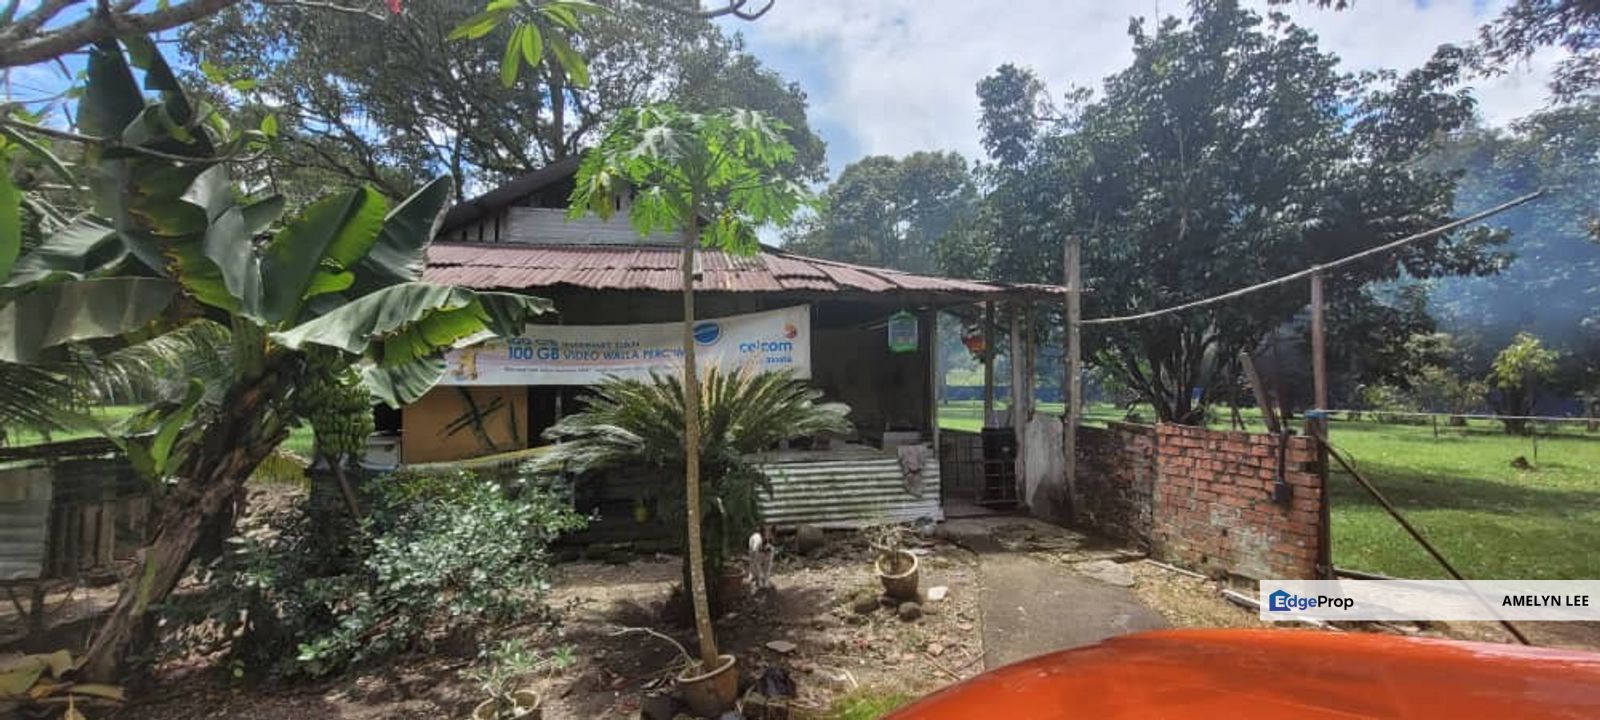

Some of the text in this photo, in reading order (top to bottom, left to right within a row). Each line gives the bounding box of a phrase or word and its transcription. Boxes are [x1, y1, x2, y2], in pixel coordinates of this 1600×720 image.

[509, 346, 533, 360] 100
[537, 347, 560, 360] GB
[739, 340, 793, 353] celcom
